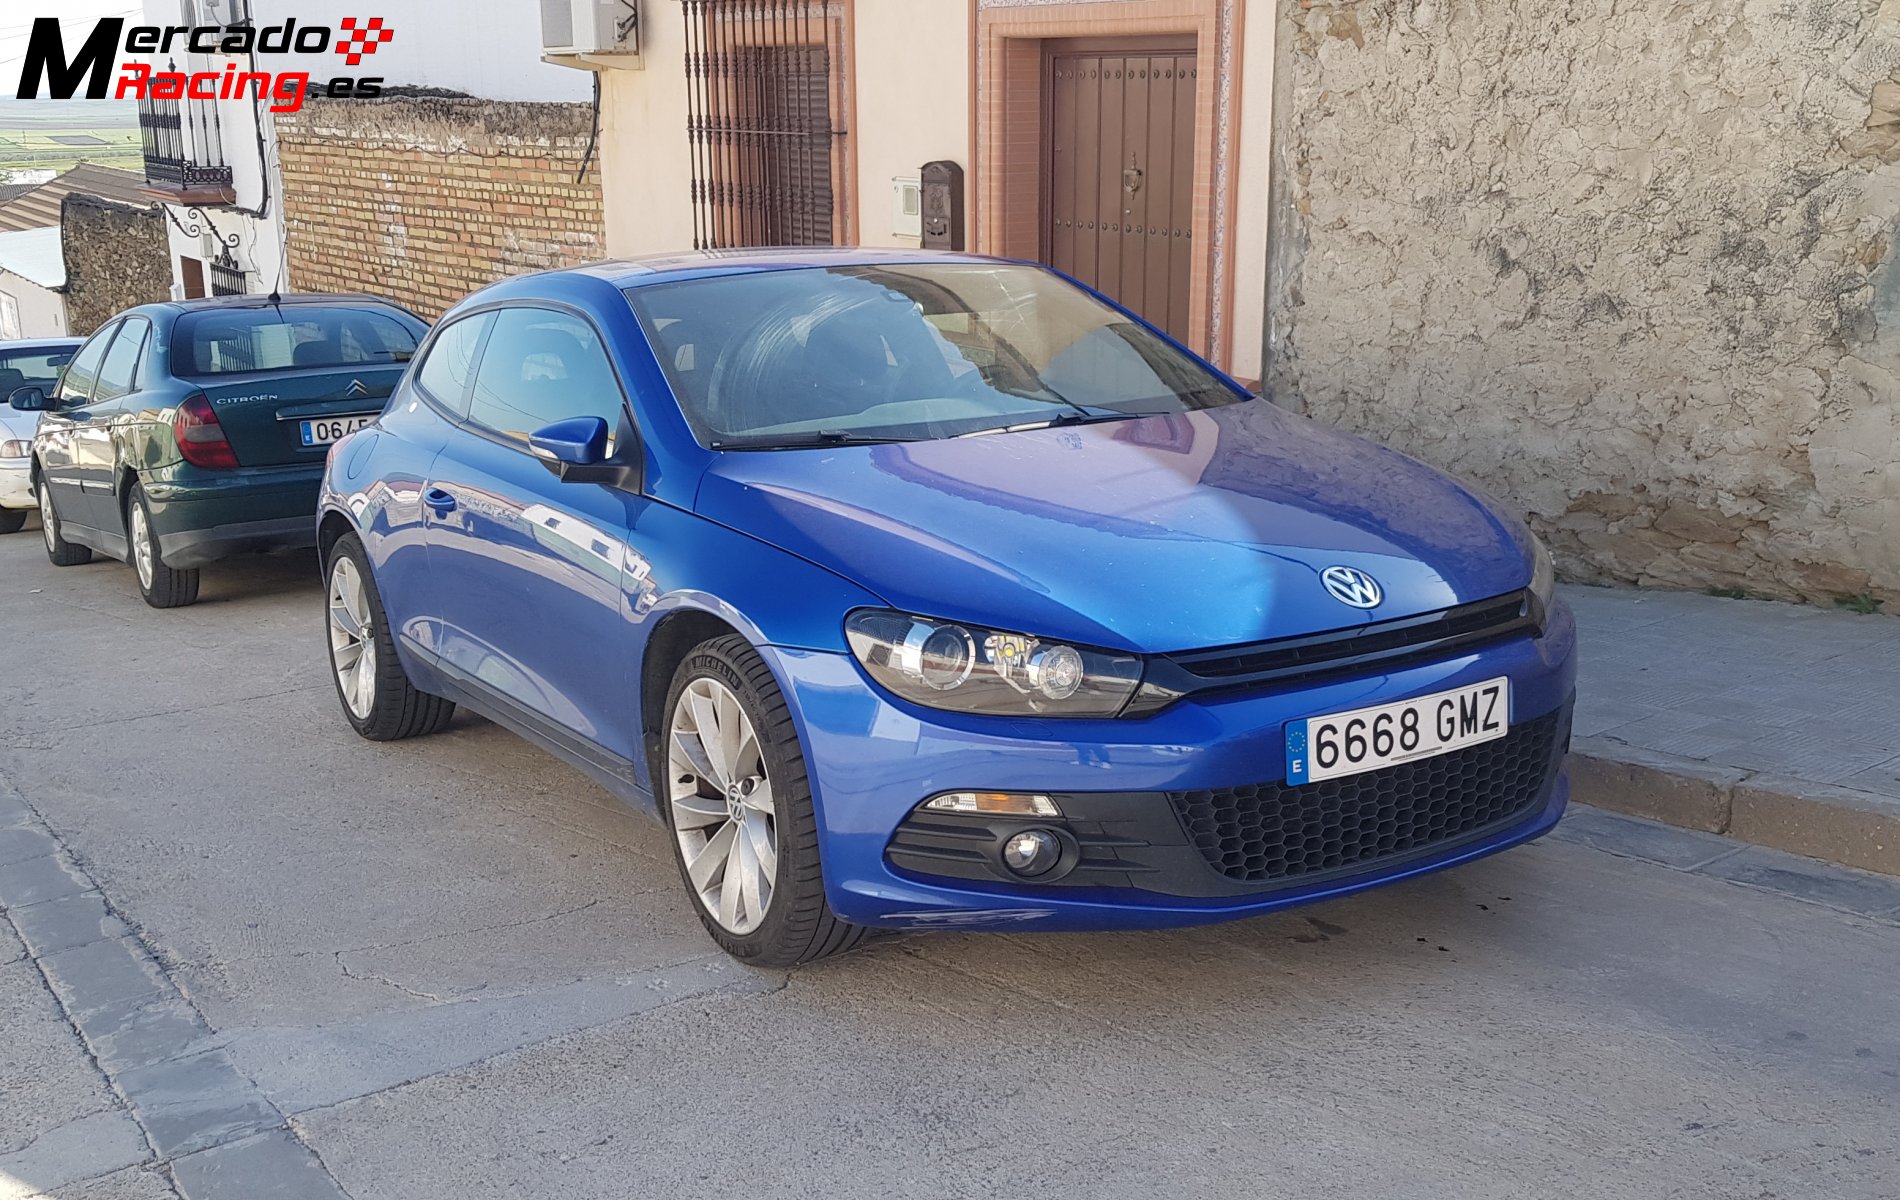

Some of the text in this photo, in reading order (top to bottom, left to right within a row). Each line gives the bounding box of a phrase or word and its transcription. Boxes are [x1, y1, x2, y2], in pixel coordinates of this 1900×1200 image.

[694, 655, 740, 687] MICHELIN
[1292, 686, 1500, 773] E 6668 GMZ
